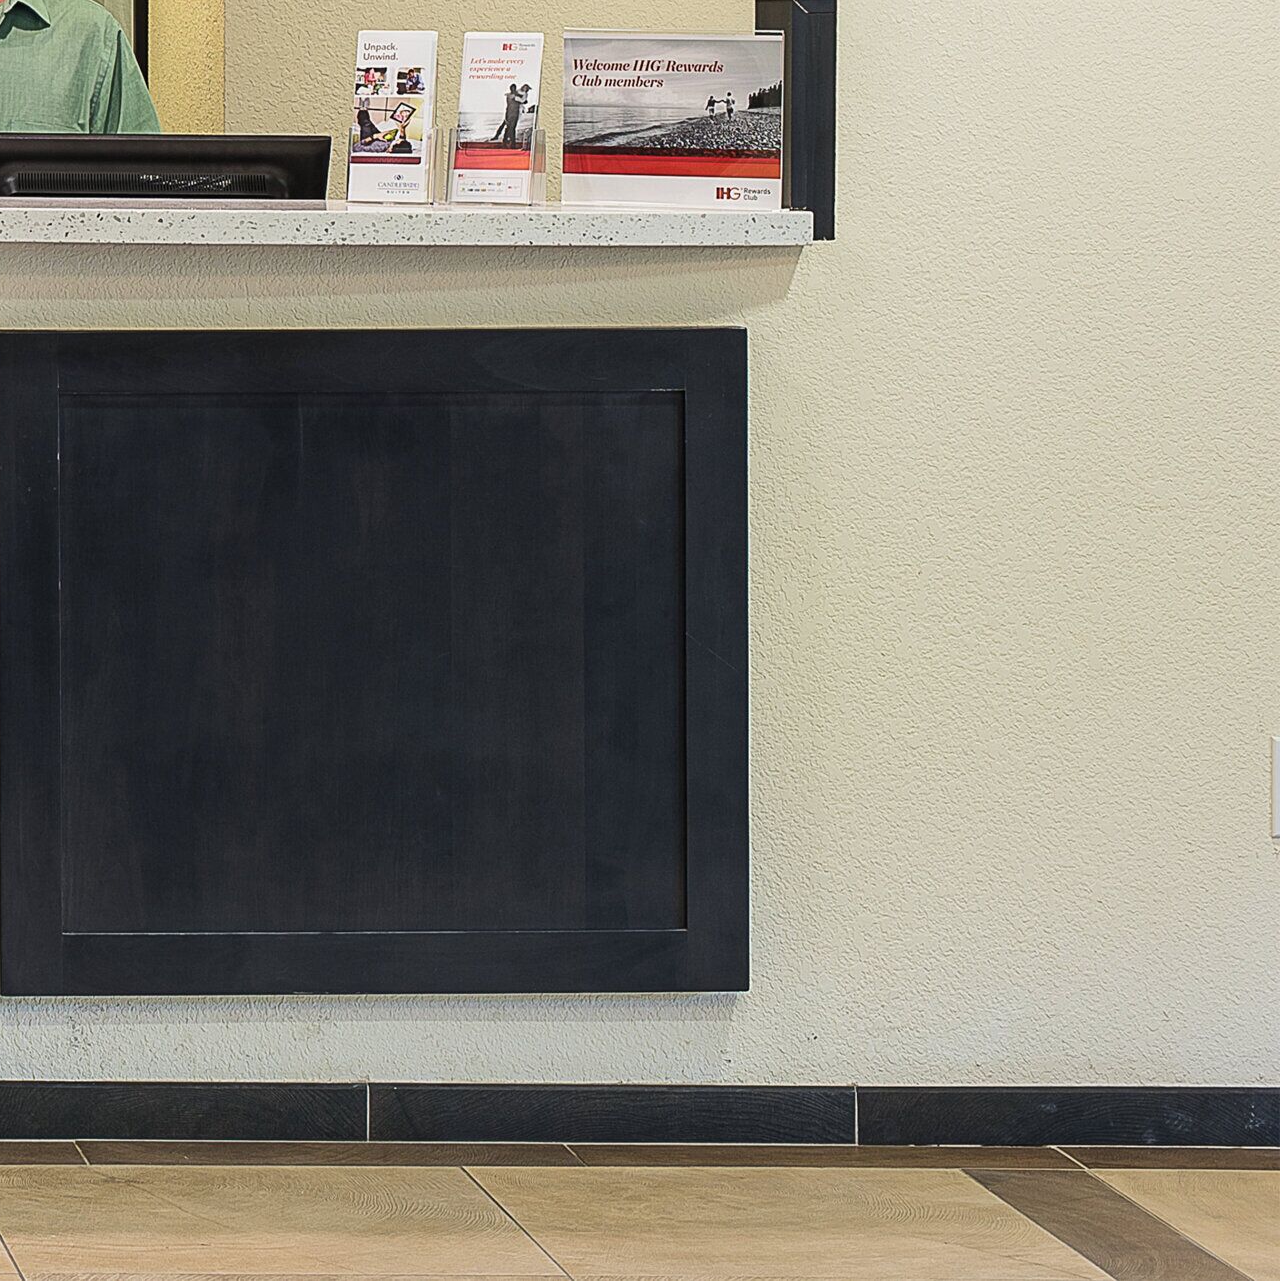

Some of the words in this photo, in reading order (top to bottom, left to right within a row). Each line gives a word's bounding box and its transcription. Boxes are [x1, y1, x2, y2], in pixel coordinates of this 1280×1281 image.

[363, 42, 398, 52] Unpack.
[502, 42, 518, 51] IHG
[363, 53, 399, 61] Unwind.
[572, 59, 631, 72] Welcome
[665, 60, 724, 73] Rewards
[572, 74, 602, 87] Club
[604, 76, 664, 88] members
[715, 187, 741, 200] IHG
